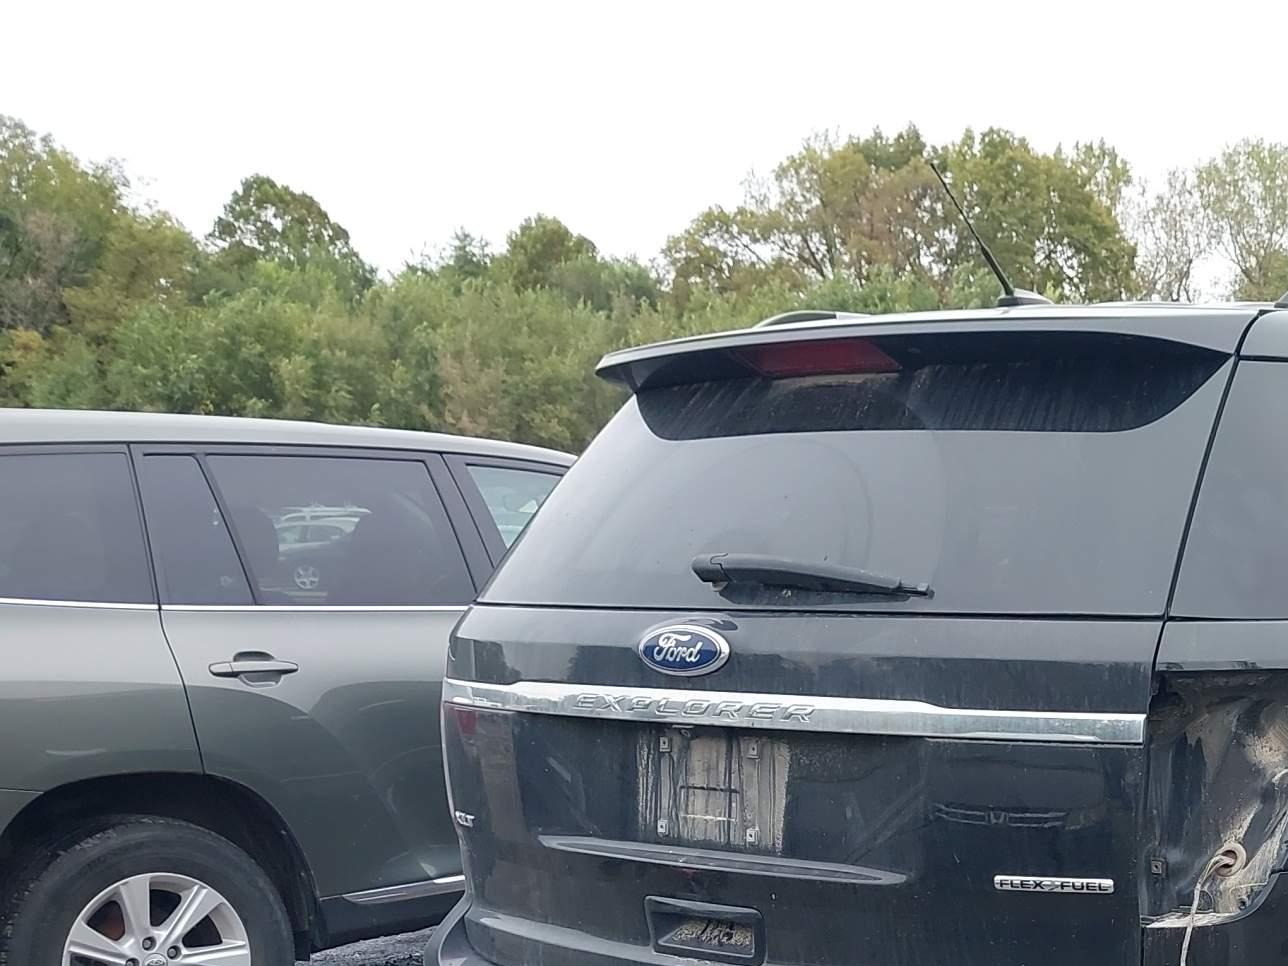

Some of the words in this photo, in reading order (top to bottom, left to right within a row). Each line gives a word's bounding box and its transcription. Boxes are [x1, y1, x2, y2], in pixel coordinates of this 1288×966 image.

[653, 632, 704, 663] Ford
[573, 691, 817, 723] EXPLORER
[999, 879, 1045, 891] FLEX
[1060, 881, 1112, 893] FUEL
